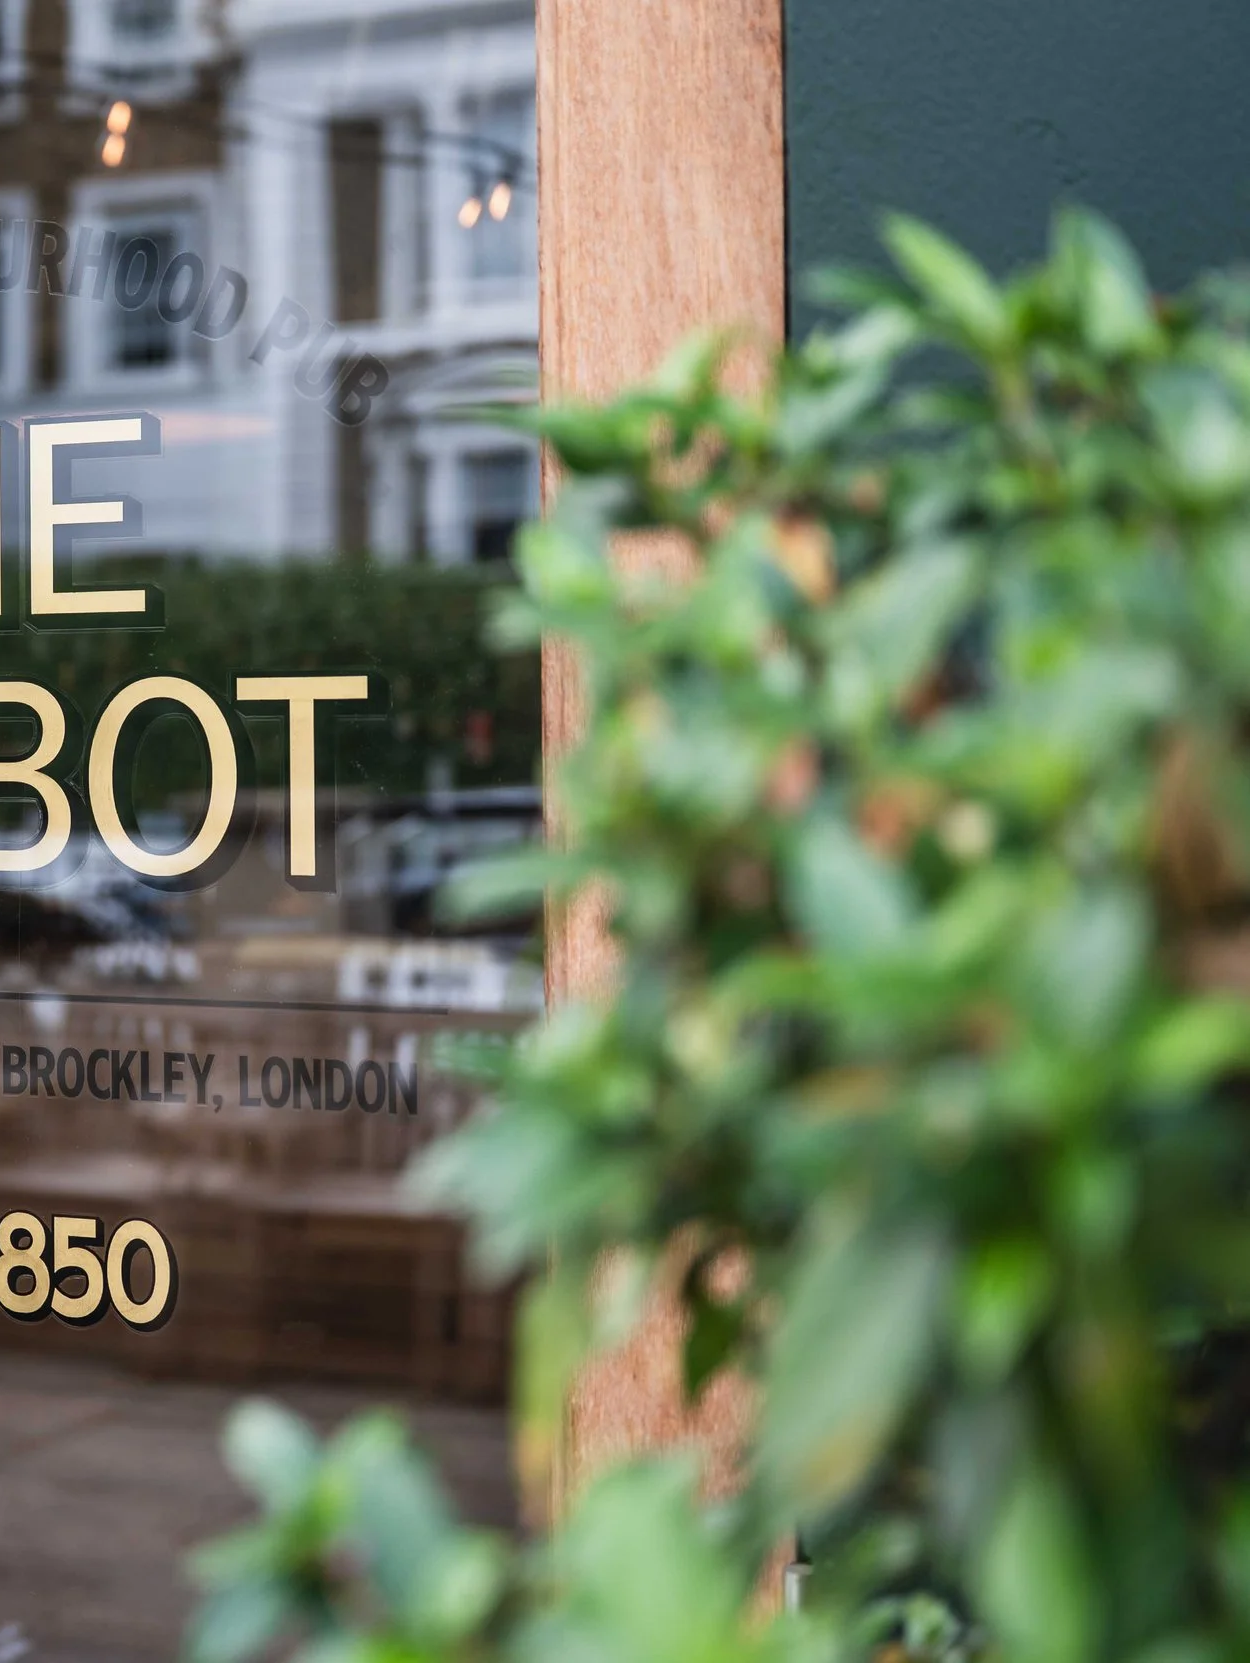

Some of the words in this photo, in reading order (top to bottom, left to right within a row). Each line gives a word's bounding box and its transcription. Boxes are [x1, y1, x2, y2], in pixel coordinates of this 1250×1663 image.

[249, 296, 389, 427] PUB
[2, 1045, 223, 1113] BROCKLEY,
[239, 1055, 418, 1115] LONDON
